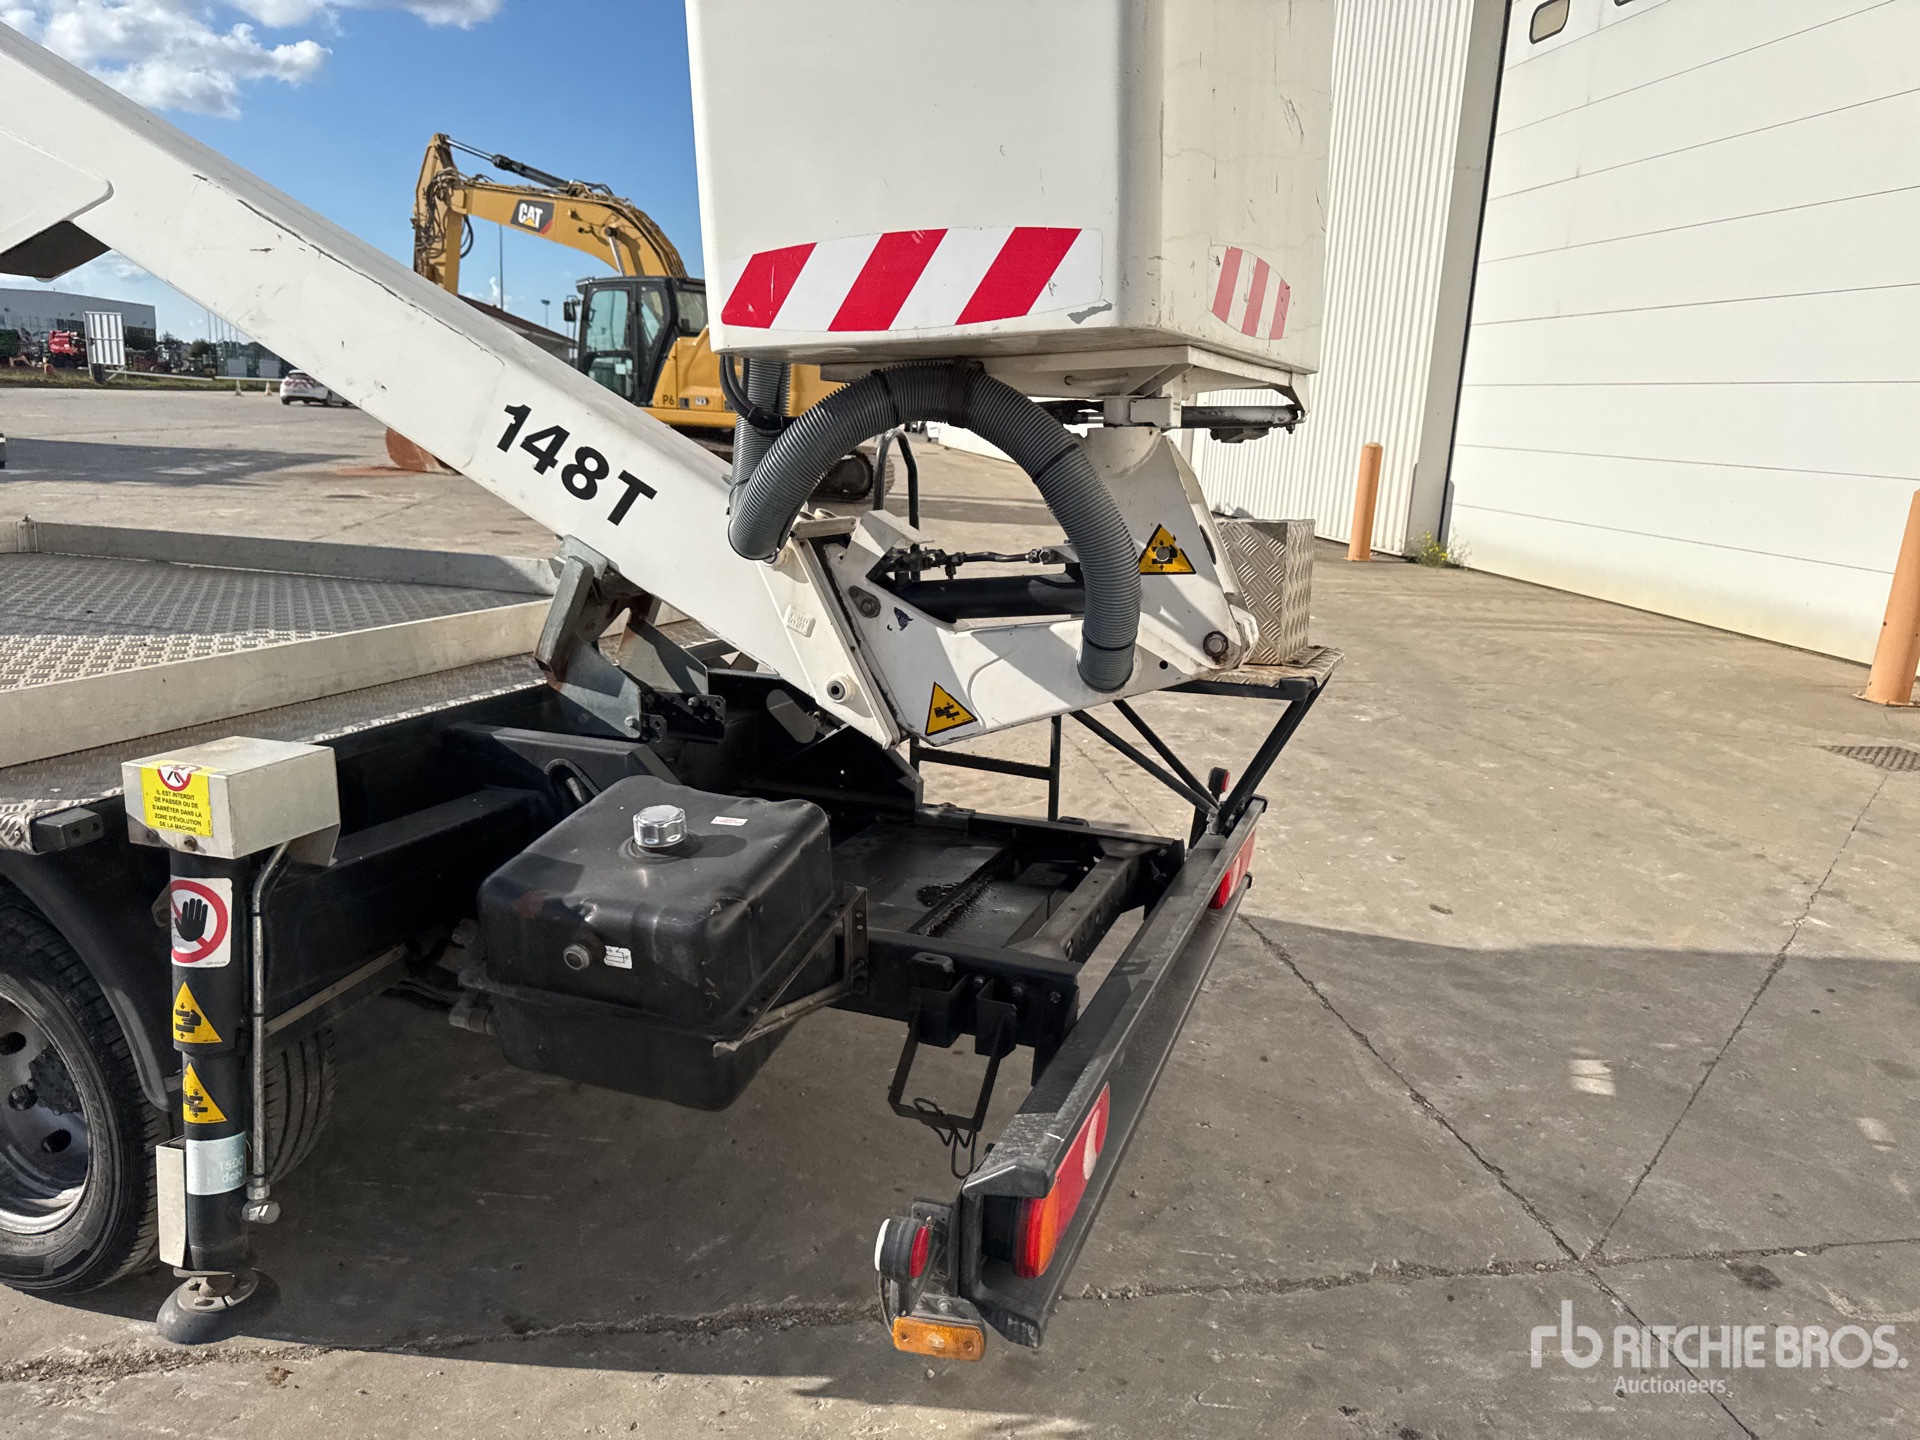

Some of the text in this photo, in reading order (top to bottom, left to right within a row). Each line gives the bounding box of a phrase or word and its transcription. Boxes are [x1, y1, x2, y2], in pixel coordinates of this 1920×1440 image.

[518, 203, 543, 228] CAT
[662, 395, 675, 405] P6
[497, 404, 658, 526] 148T
[162, 797, 182, 805] PASSER
[172, 792, 195, 800] INTERDIT
[152, 804, 179, 814] S'ARRÊTER
[169, 815, 202, 826] D'ÉVOLUTION
[174, 824, 197, 832] MACHINE
